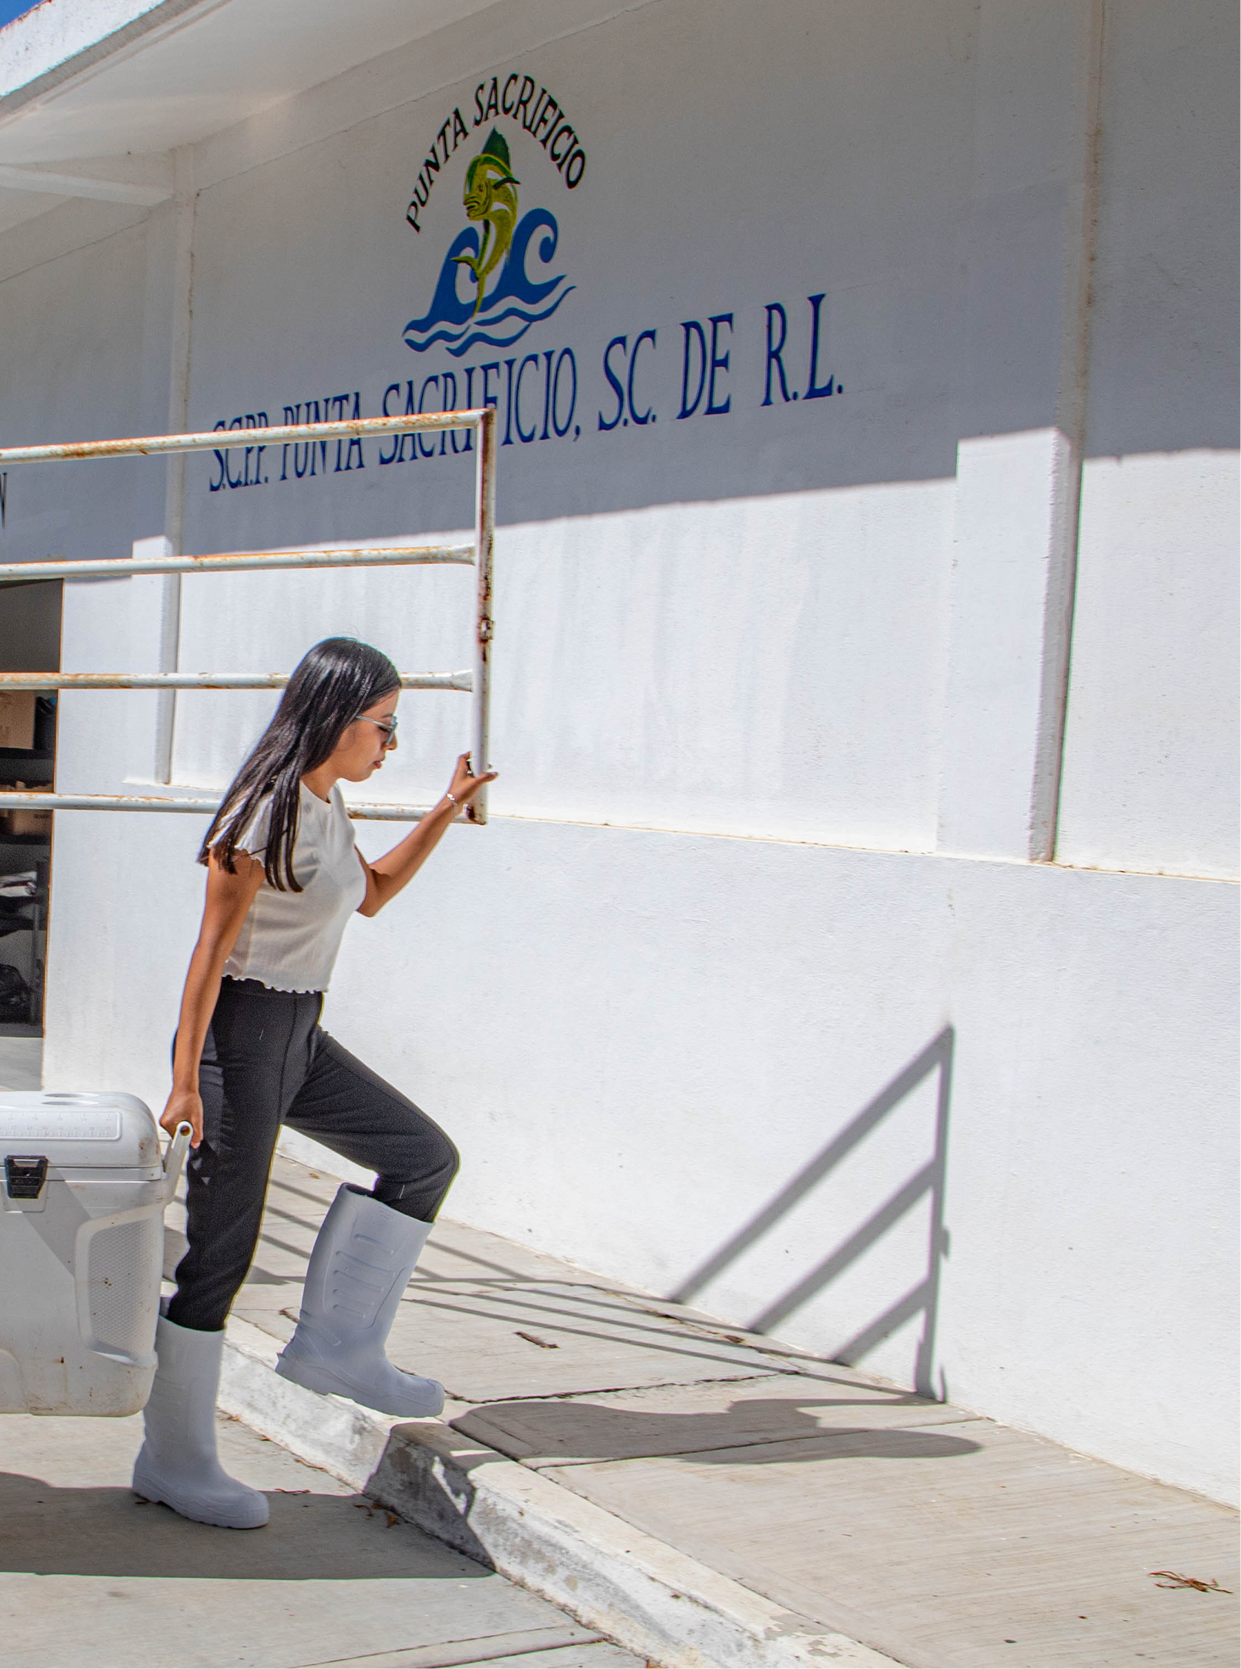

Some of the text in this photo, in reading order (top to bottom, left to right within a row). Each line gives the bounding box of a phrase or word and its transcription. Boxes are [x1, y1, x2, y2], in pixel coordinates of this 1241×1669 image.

[405, 73, 586, 235] PUNTA SACRIFICIO
[279, 391, 365, 481] PUNTA
[379, 347, 581, 465] SACRIFICIO,
[598, 328, 657, 431] S.C.
[676, 312, 734, 420] DE
[760, 293, 843, 407] R.L.
